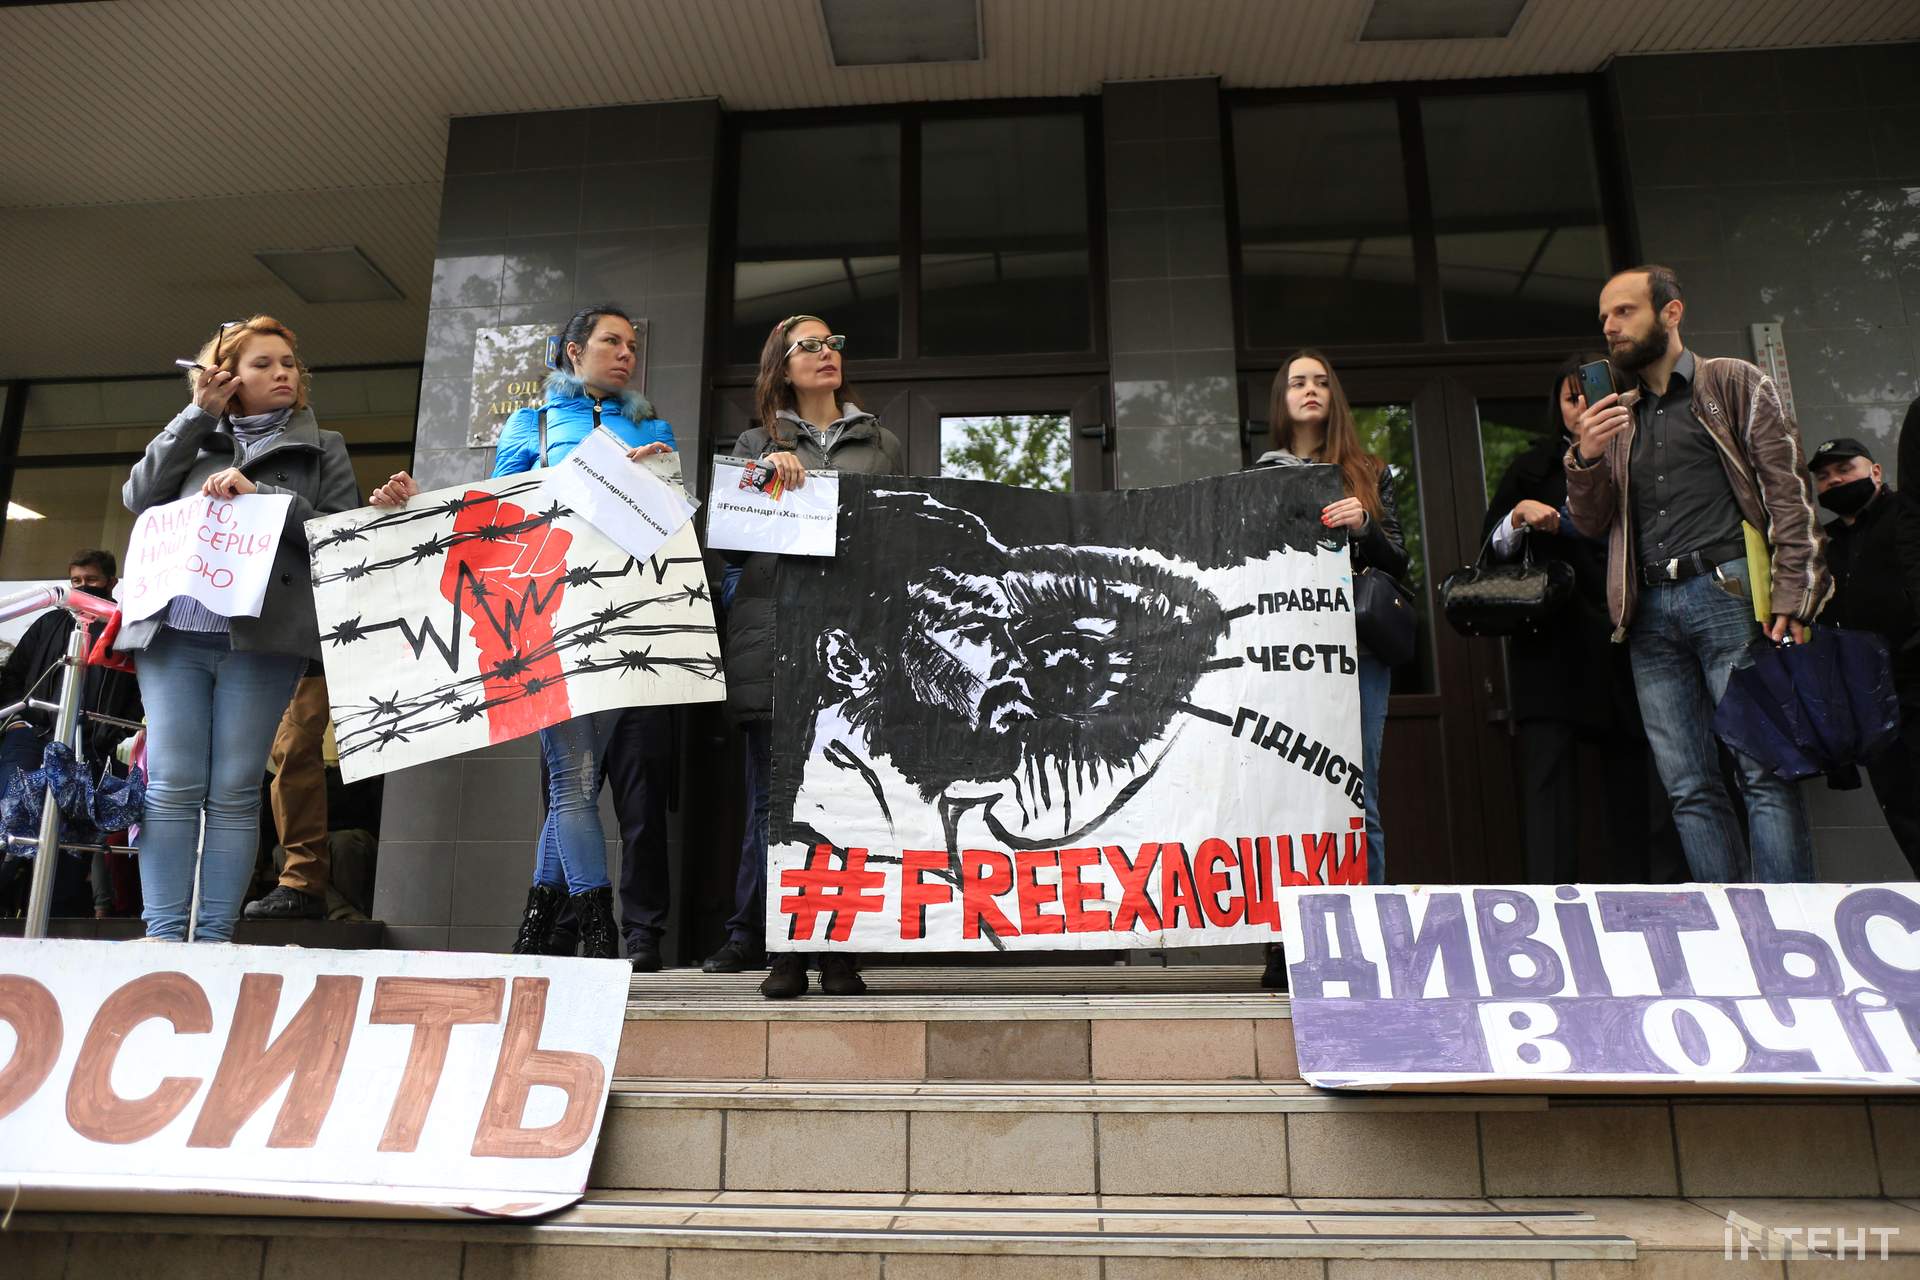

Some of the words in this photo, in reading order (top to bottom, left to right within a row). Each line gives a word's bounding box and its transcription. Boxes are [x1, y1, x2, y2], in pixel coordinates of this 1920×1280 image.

[572, 456, 669, 537] #FreeАндрійХаєцький
[197, 524, 272, 557] СЕРЦЯ
[1258, 587, 1350, 615] ПРАВДА
[1246, 643, 1357, 675] ЧЕСТЬ
[1231, 706, 1366, 810] ГІДНІСТЬ
